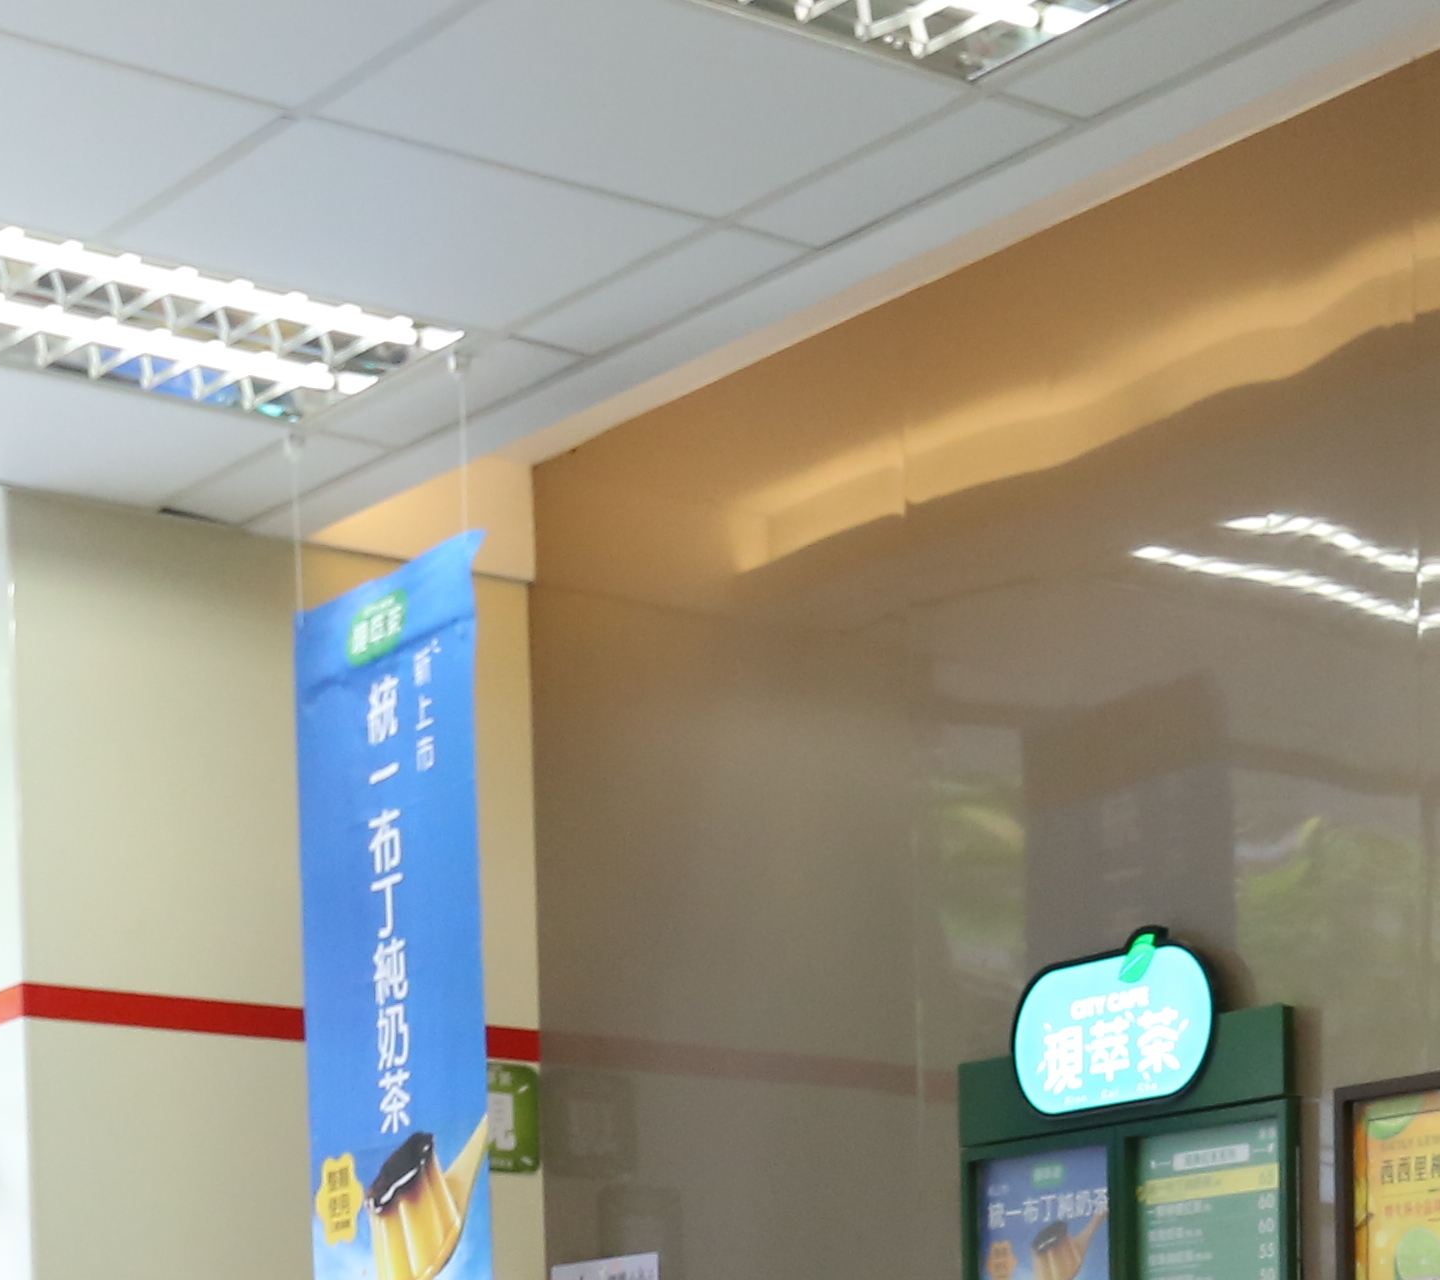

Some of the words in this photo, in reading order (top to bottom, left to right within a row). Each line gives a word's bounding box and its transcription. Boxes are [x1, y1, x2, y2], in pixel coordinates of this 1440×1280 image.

[367, 675, 411, 1135] 統一布丁純奶茶
[1042, 1005, 1182, 1095] 現萃茶
